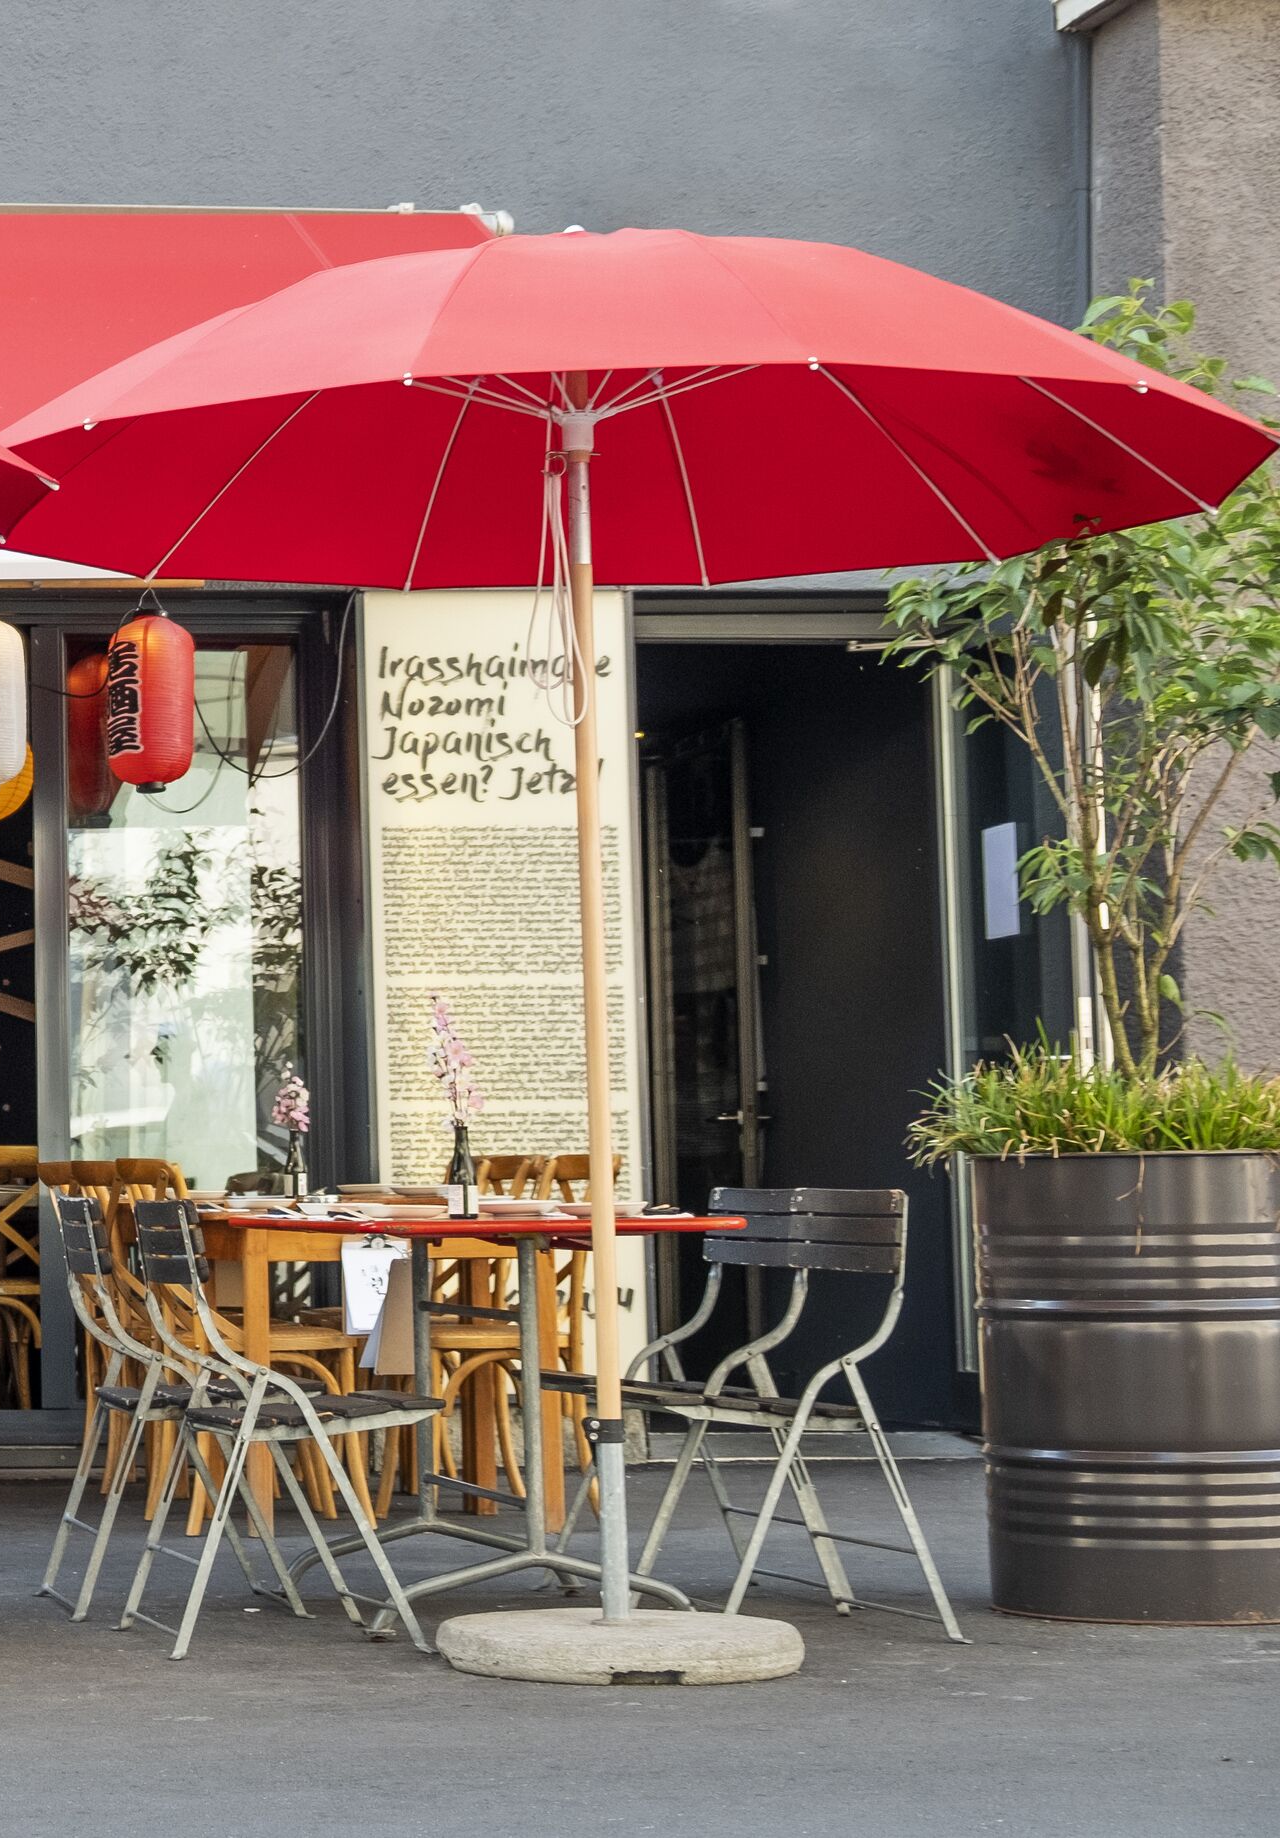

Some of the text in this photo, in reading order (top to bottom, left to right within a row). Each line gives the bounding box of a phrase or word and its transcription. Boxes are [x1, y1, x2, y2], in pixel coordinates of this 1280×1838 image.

[378, 642, 612, 687] Irasshaimae
[381, 676, 507, 721] Nozomi
[371, 718, 555, 772] Japanisch
[382, 764, 494, 803] essen?
